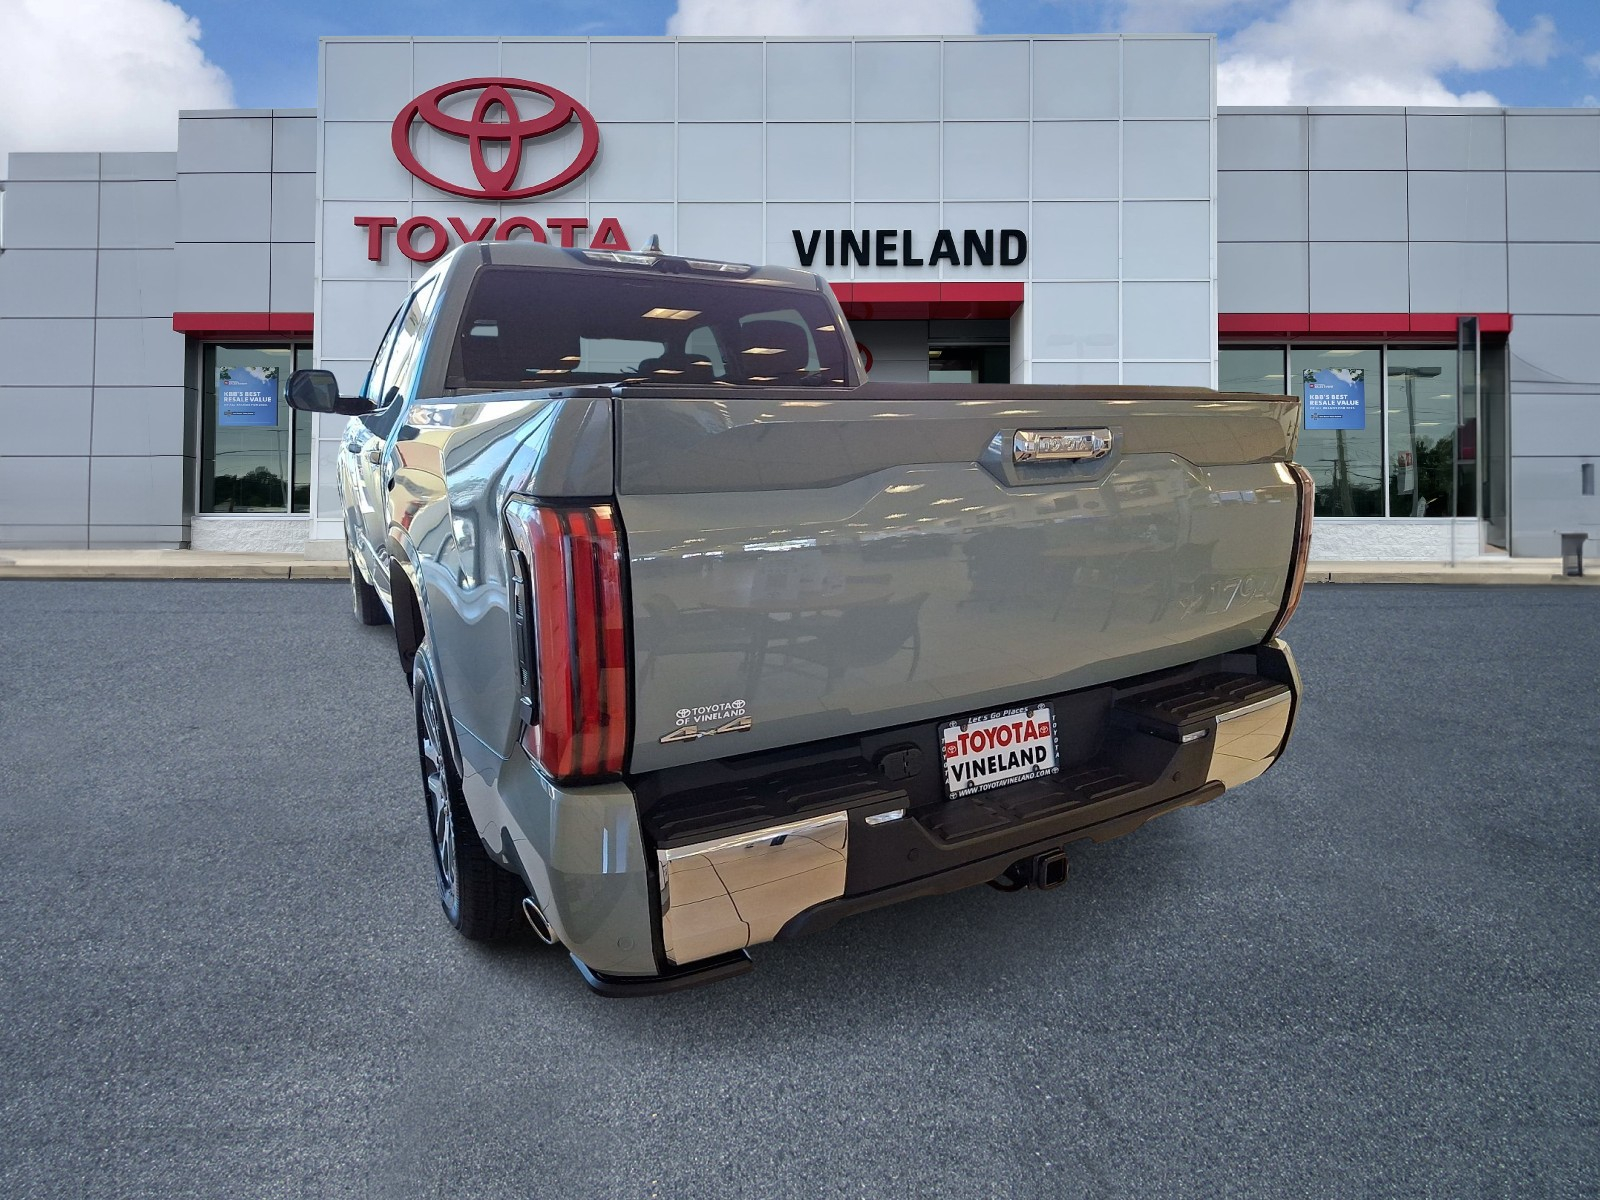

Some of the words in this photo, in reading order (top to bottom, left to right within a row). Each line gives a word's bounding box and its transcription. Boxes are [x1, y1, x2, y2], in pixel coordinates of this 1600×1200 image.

[353, 215, 632, 263] TOYOTA
[791, 229, 1028, 267] VINELAND
[675, 717, 690, 726] OF
[693, 708, 746, 723] VINELAND
[691, 702, 732, 716] TOYOTA
[968, 714, 988, 724] Let's
[990, 711, 1001, 719] Go
[1003, 706, 1029, 717] Places
[958, 719, 1039, 756] TOYOTA
[950, 745, 1047, 783] VINELAND
[958, 768, 1052, 798] WWW.TOYOTAVINELAND.COM
